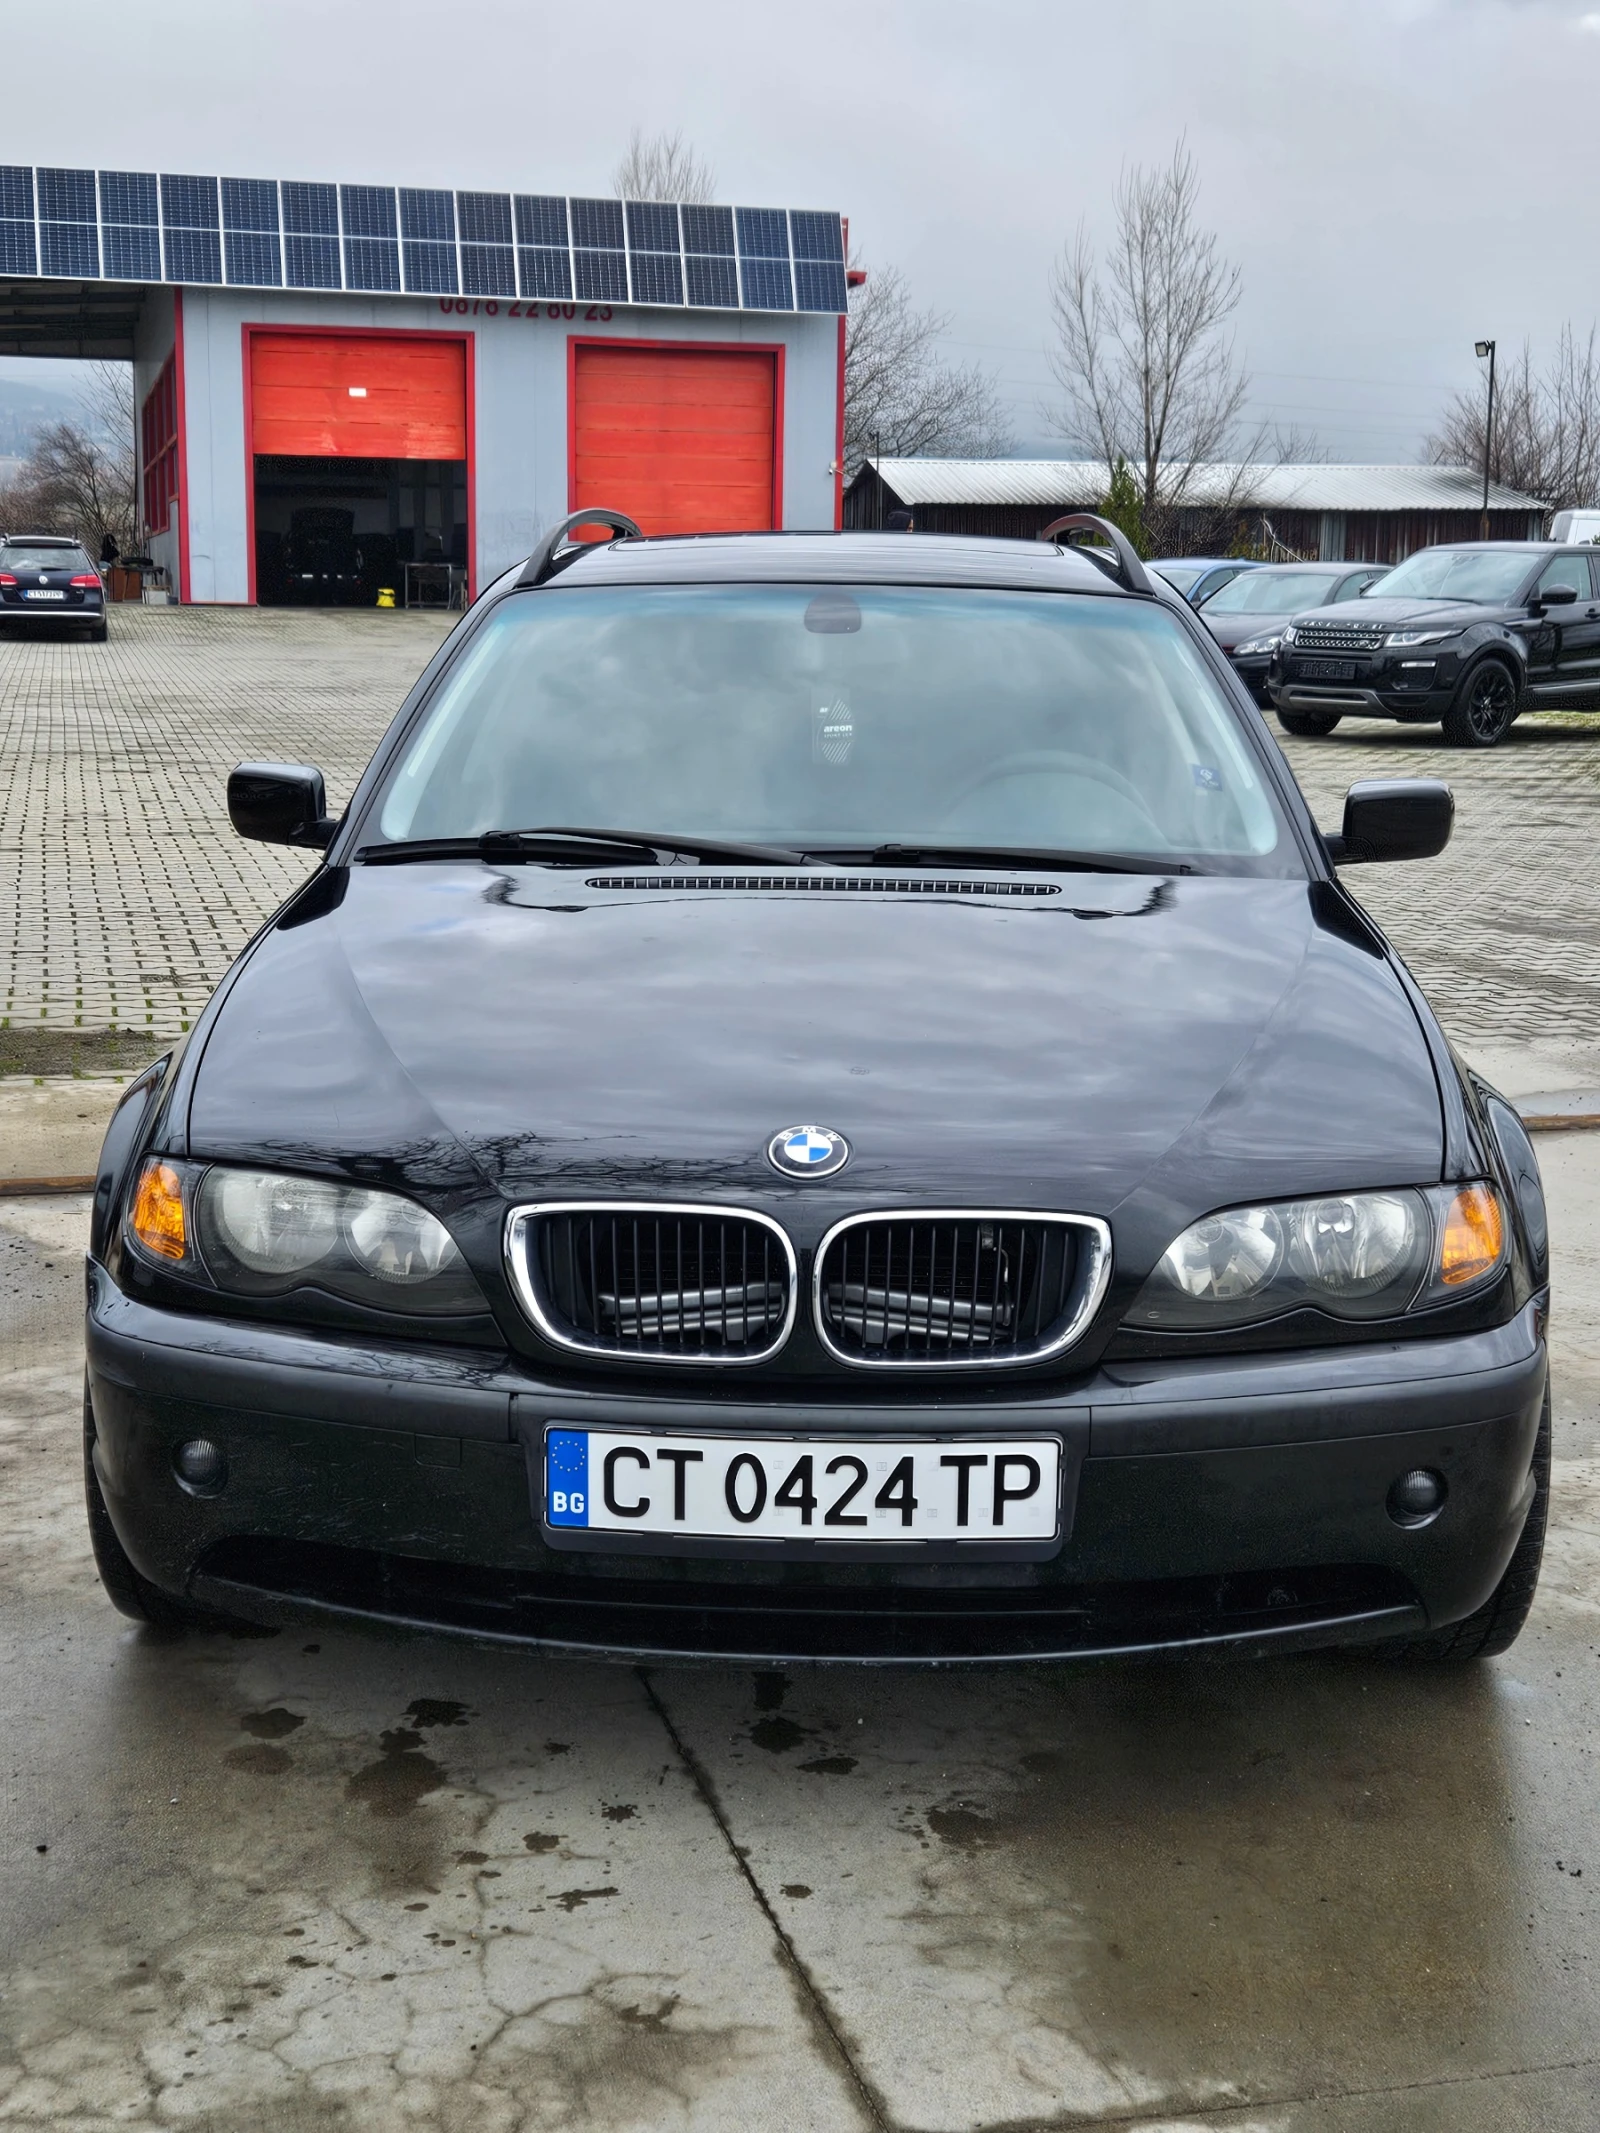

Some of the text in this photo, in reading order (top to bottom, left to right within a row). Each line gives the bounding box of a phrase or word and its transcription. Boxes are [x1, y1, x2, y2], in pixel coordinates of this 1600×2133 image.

[779, 1126, 840, 1141] BMW
[603, 1446, 1041, 1527] CT 0424 TP
[553, 1491, 585, 1514] BG
